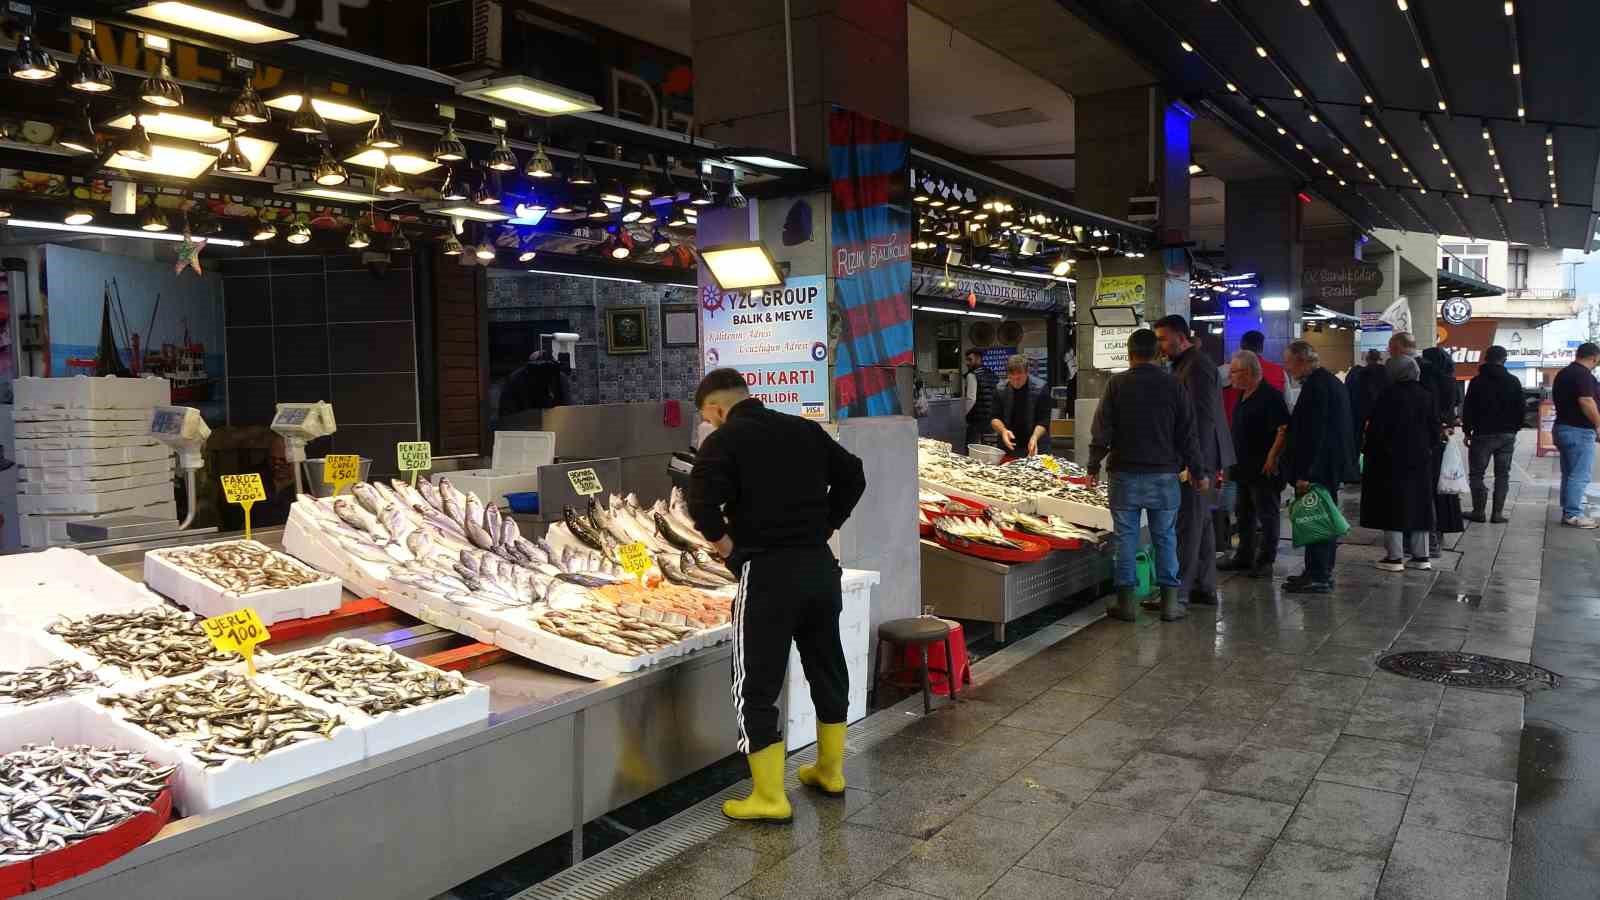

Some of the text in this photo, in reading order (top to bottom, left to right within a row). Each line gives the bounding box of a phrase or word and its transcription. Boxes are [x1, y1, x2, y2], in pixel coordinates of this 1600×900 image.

[761, 287, 818, 307] GROUP
[733, 310, 813, 325] BALIK & MEYVE
[767, 369, 816, 386] KARTI
[228, 624, 257, 645] 100
